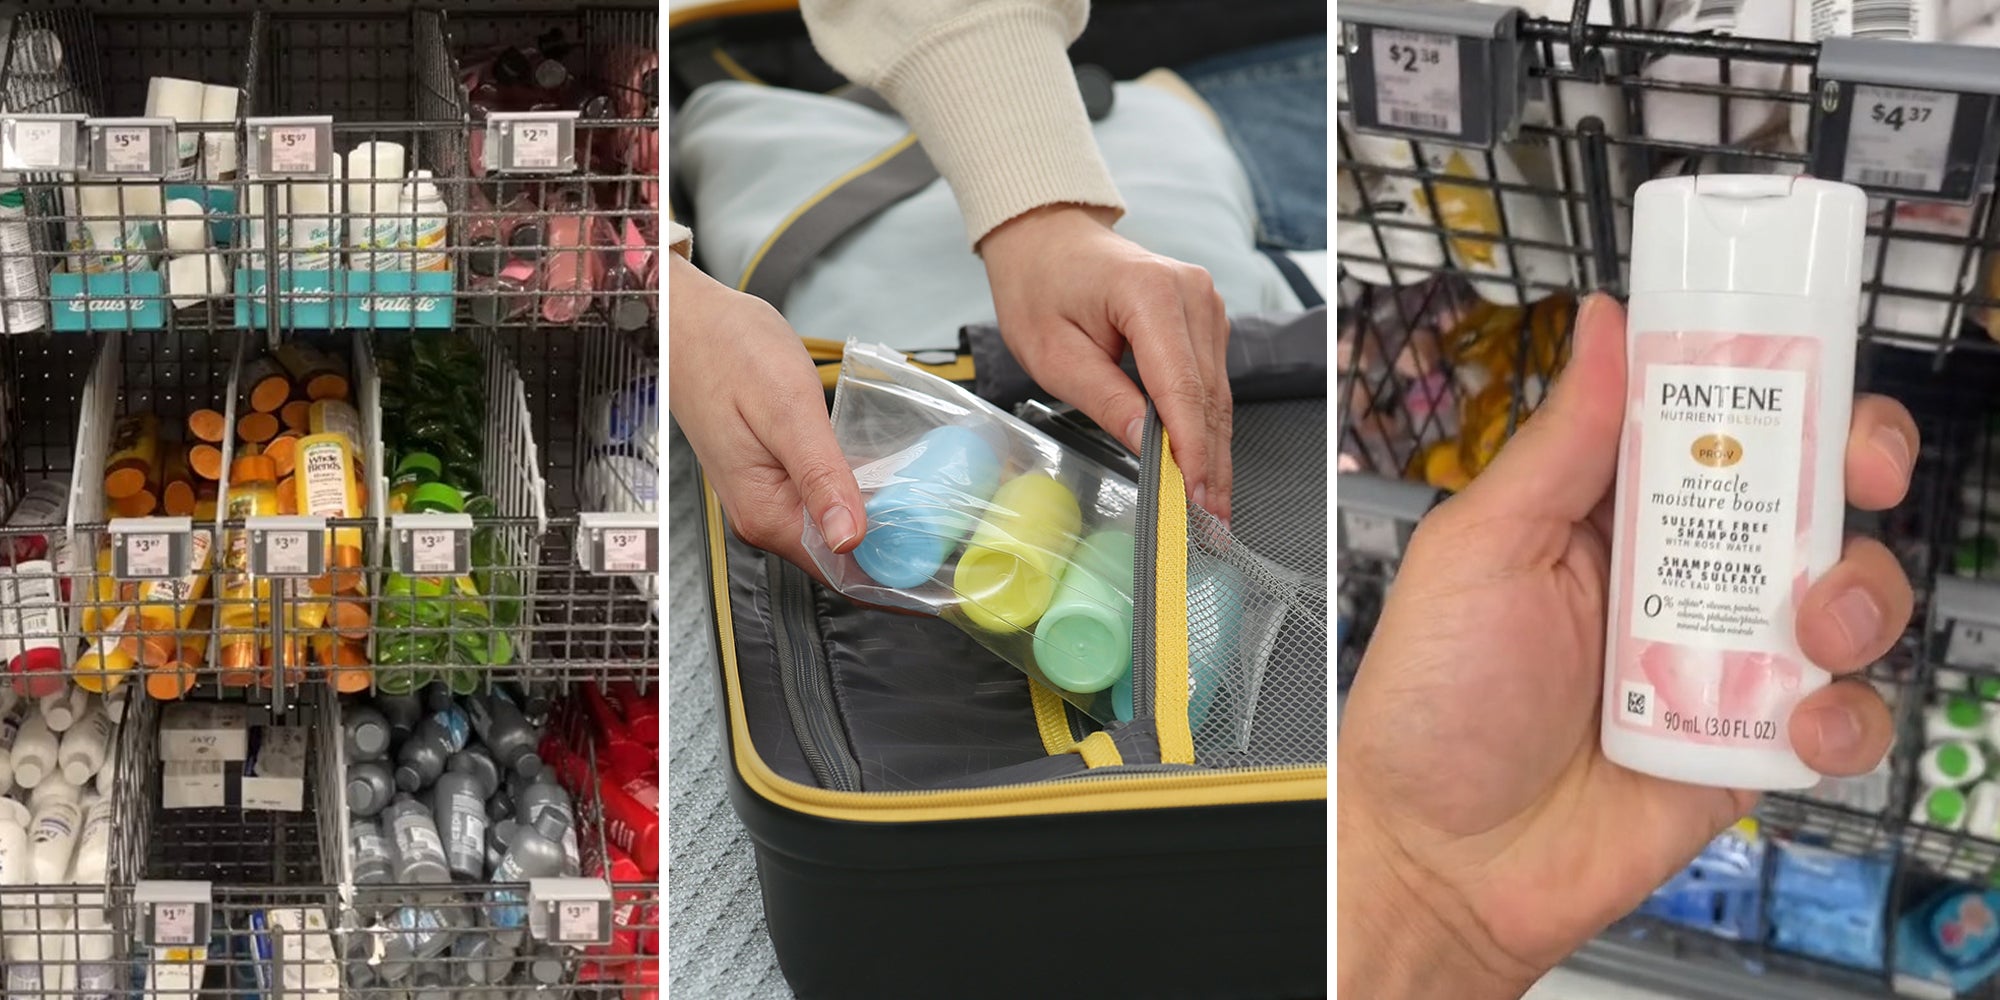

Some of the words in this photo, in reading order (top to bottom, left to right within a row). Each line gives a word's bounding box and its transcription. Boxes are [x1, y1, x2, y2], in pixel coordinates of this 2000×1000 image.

[1661, 382, 1783, 412] PANTENE
[1660, 410, 1724, 423] NUTRIENT
[1727, 414, 1781, 427] BLENDS
[1699, 448, 1734, 460] PRO-V
[1681, 474, 1749, 494] miracle
[1651, 491, 1725, 510] moisture
[1732, 492, 1781, 514] boost
[1661, 515, 1724, 531] SULFATE
[1732, 521, 1769, 534] FREE
[1665, 537, 1690, 548] WITH
[1694, 540, 1721, 551] ROSE
[1726, 542, 1762, 553] WATER
[1677, 527, 1750, 544] SHAMPOO
[1662, 556, 1763, 575] SHAMPOOING
[1657, 566, 1693, 580] SANS
[1701, 569, 1768, 586] SULFATE
[1661, 578, 1687, 589] AVEC
[1690, 581, 1710, 591] EAU
[1714, 583, 1728, 592] DE
[1732, 584, 1761, 595] ROSE
[1664, 711, 1680, 731] 90
[1682, 715, 1701, 734] mL
[1704, 717, 1731, 737] (3.0
[1733, 720, 1749, 739] FL
[1754, 721, 1776, 741] OZ)
